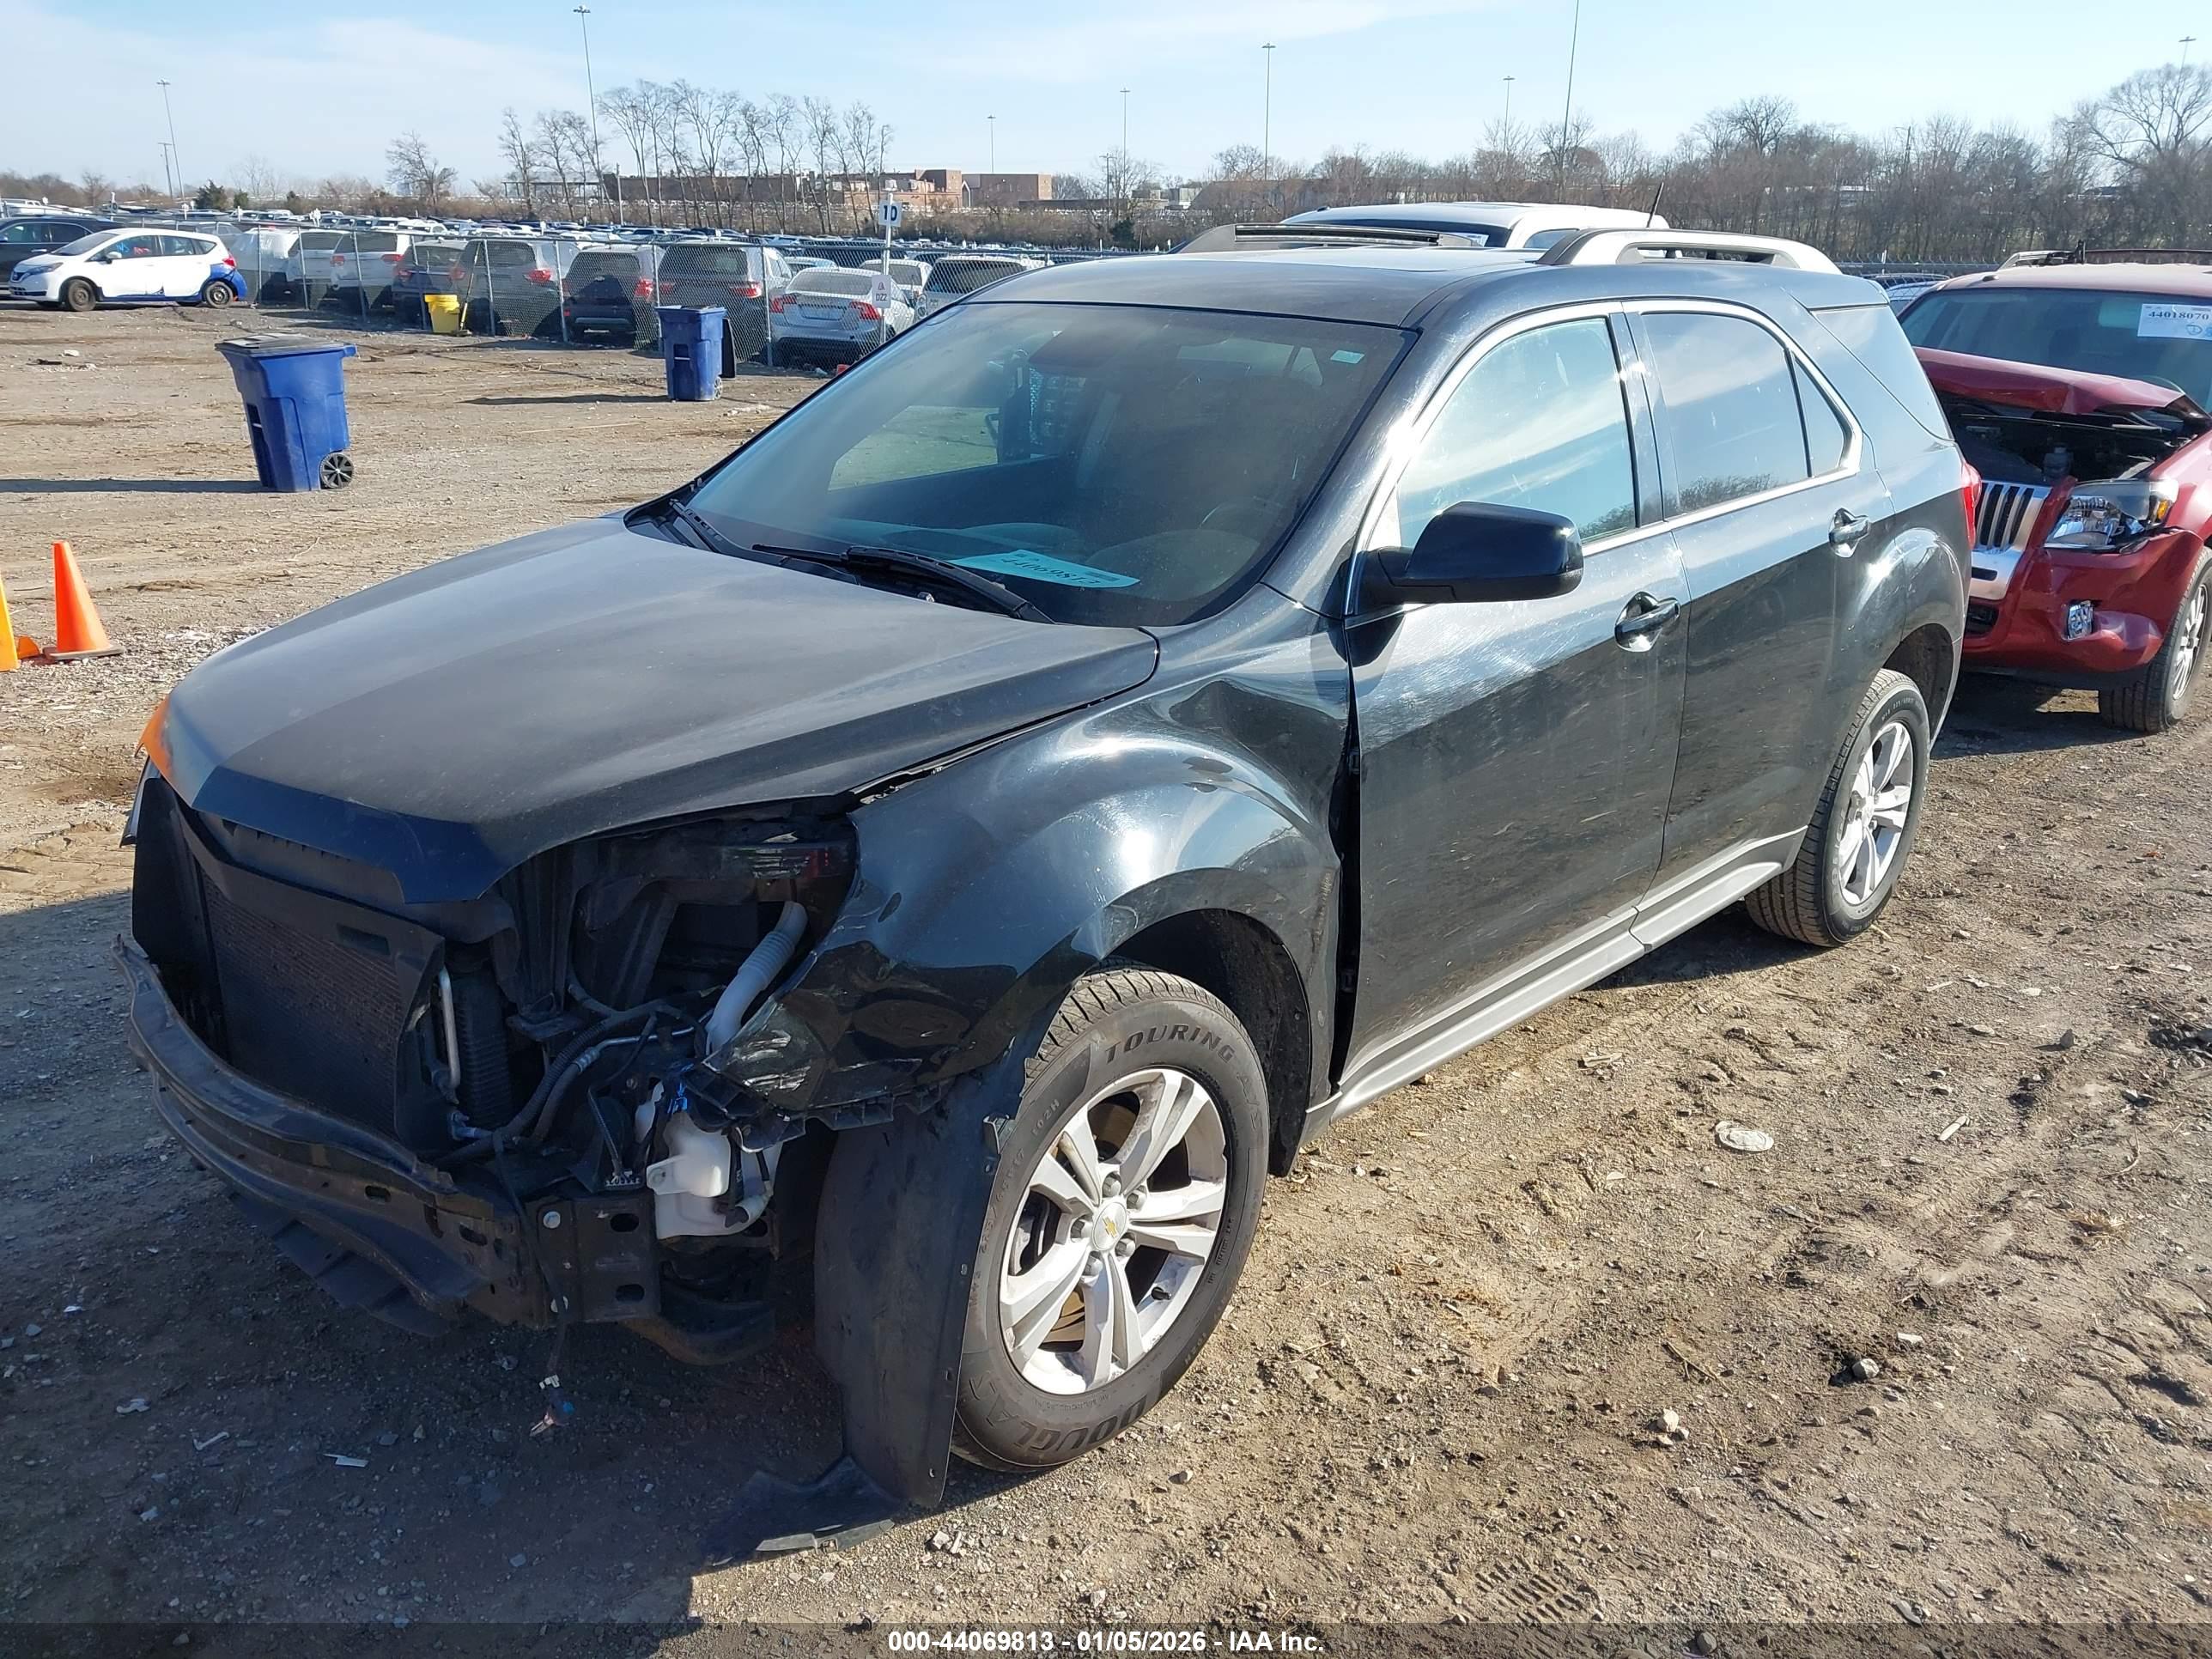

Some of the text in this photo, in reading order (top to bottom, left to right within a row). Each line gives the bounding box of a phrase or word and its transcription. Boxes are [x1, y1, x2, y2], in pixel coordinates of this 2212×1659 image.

[2148, 311, 2209, 320] 44018070
[1105, 1024, 1236, 1065] TOURING
[969, 1374, 1148, 1453] DOUGLAS
